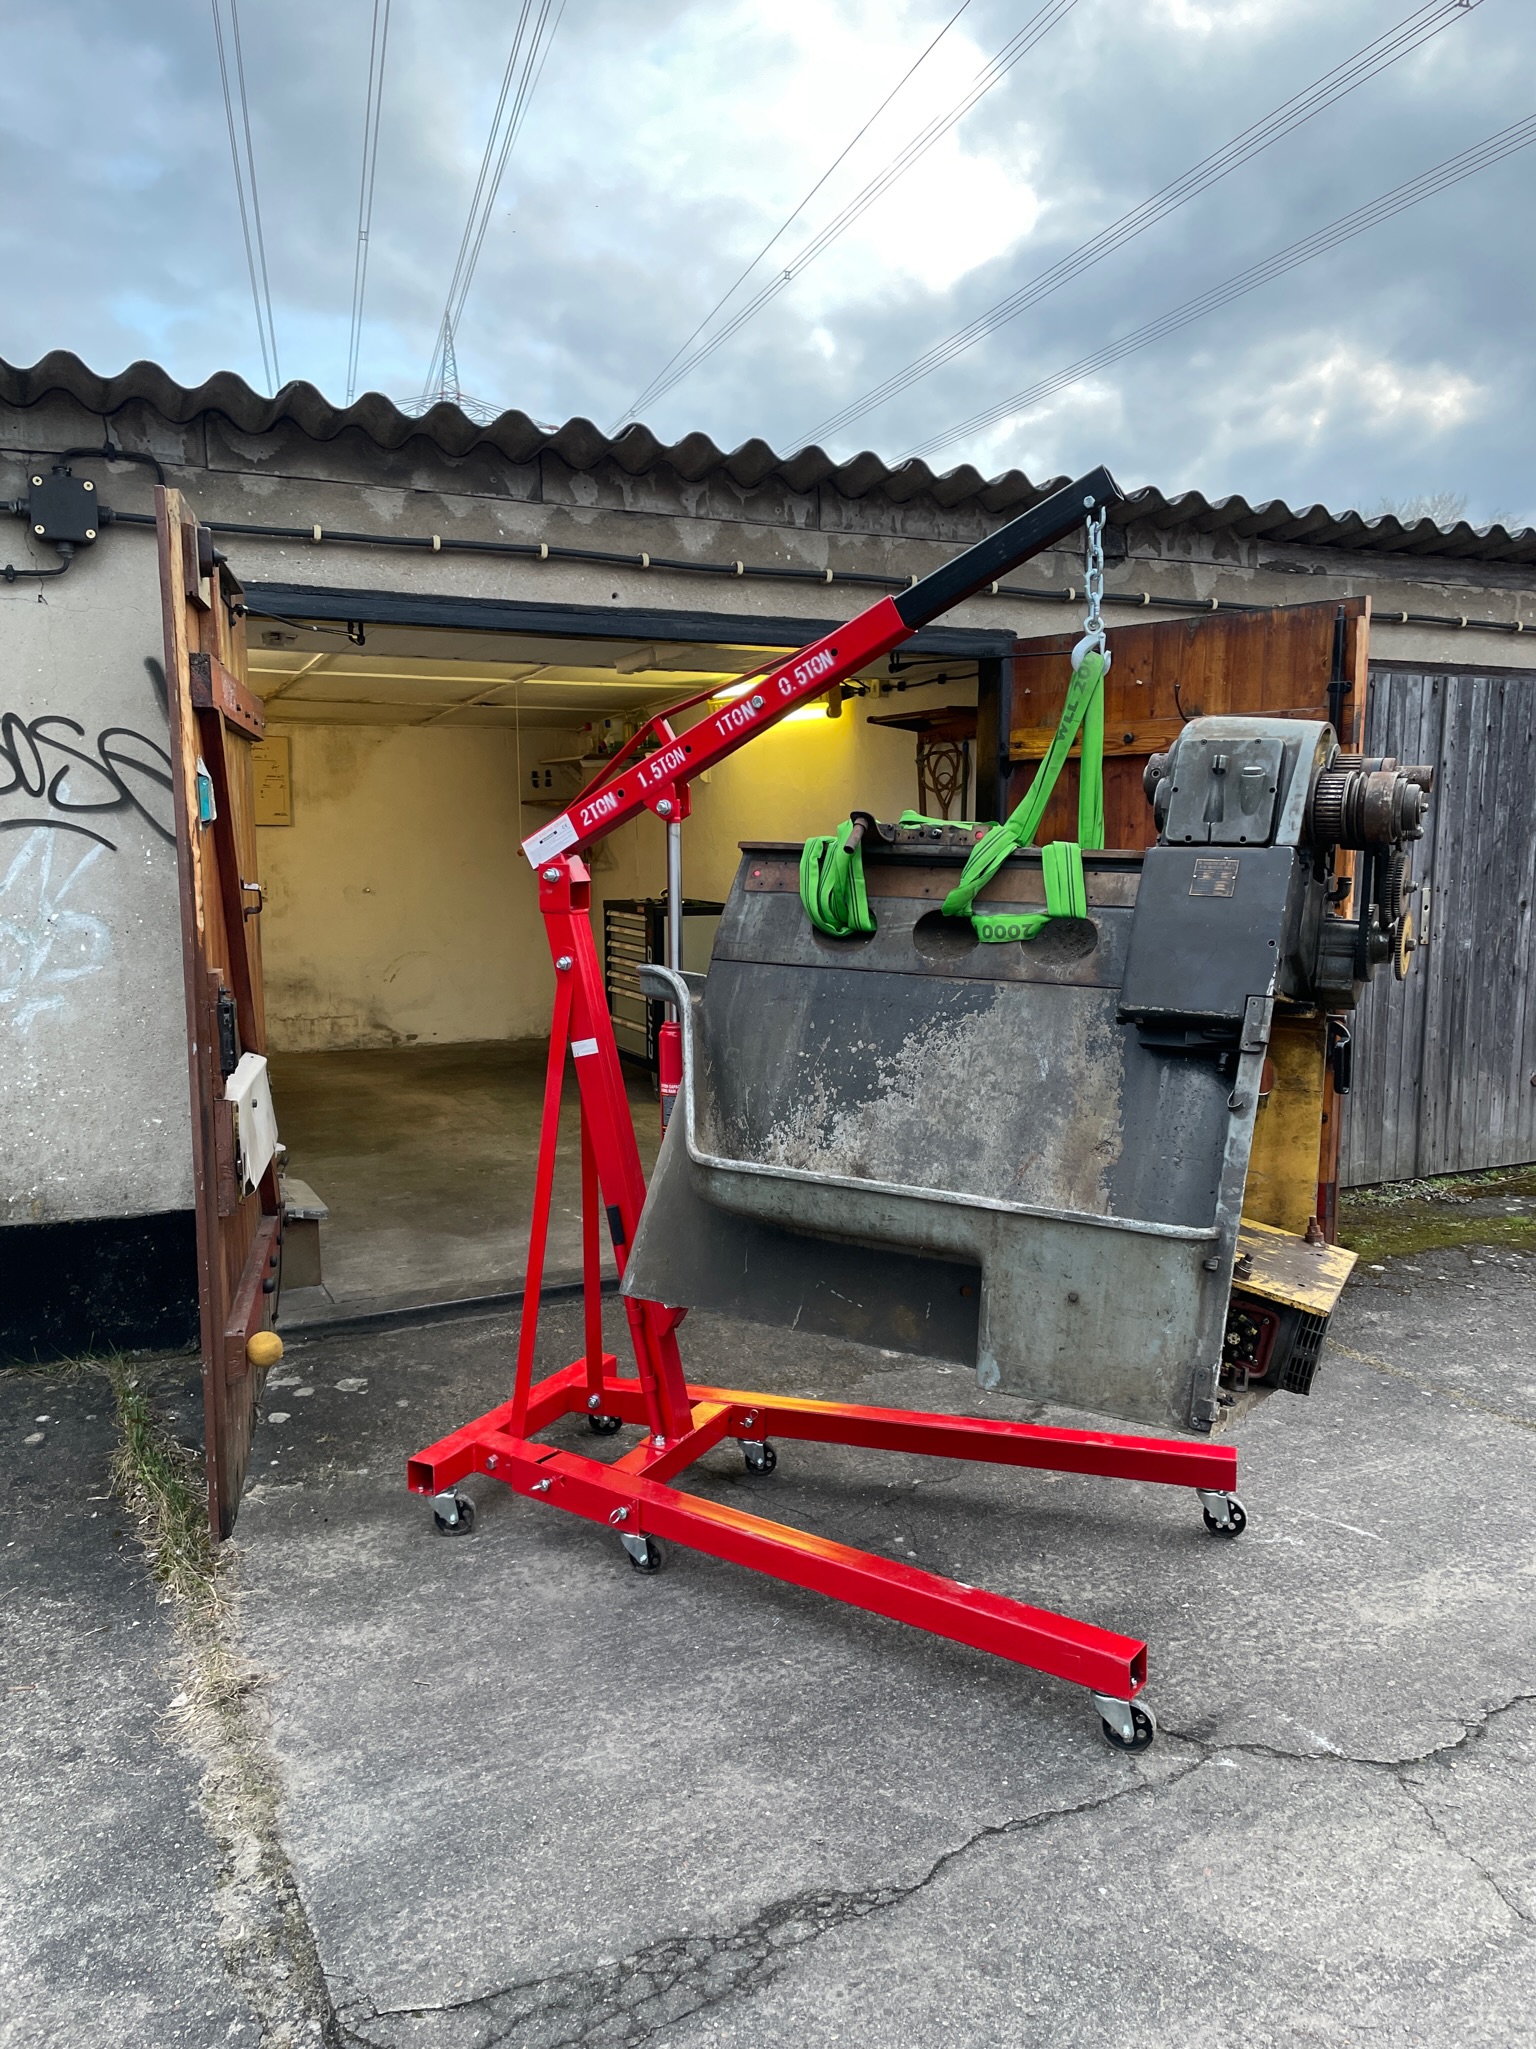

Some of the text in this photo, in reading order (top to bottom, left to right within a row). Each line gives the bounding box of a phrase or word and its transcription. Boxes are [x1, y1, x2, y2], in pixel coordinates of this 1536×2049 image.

[778, 649, 835, 696] 0.5TON
[715, 700, 757, 736] 1TON
[1056, 702, 1080, 741] WLL
[637, 746, 686, 788] 1.5TON
[580, 792, 618, 827] 2TON
[981, 923, 1032, 940] 2000
